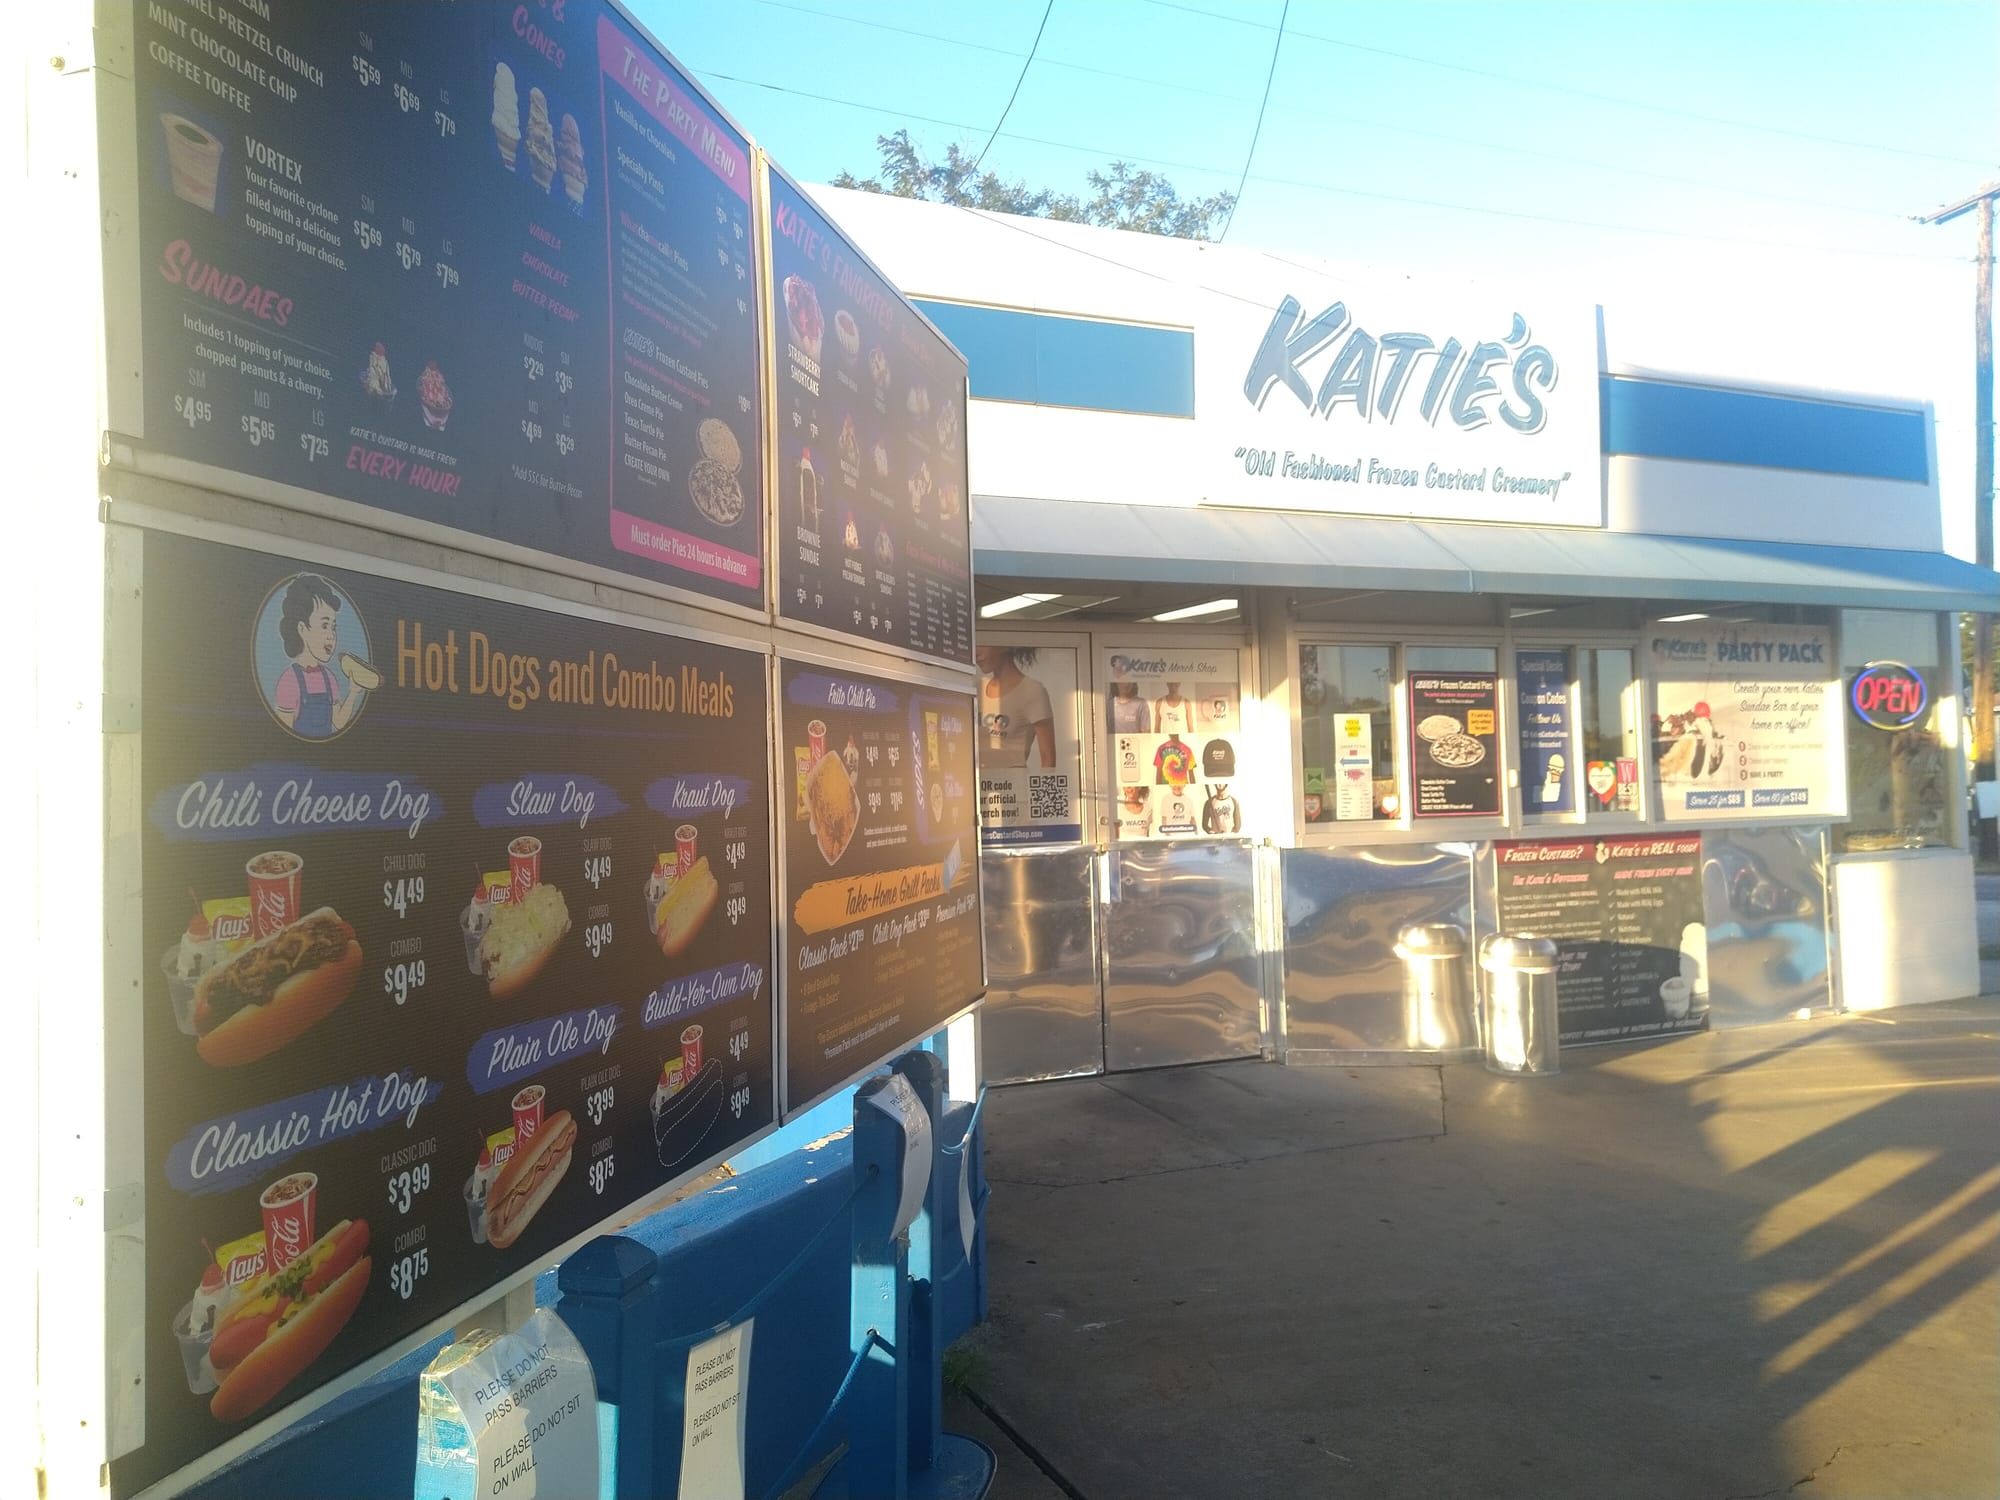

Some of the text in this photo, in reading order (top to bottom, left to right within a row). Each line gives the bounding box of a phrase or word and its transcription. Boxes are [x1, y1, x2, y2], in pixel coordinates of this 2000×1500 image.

[149, 3, 188, 39] MINT
[190, 27, 267, 88] CHOCOLATE
[268, 75, 298, 104] CHIP
[218, 6, 274, 57] PRETZEL
[275, 45, 324, 88] CRUNCH
[512, 4, 566, 70] CONES
[149, 41, 251, 113] COFFEE TOFFEE
[614, 99, 639, 132] Vanilla
[646, 127, 676, 164] Chocolate
[623, 46, 736, 179] THE PARTY MENU
[245, 135, 303, 185] VORTEX
[245, 166, 339, 225] Your favorite cyclone
[246, 189, 270, 212] filled
[272, 202, 294, 226] with
[302, 218, 342, 248] delicious
[246, 213, 348, 272] topping of your choice.
[776, 199, 831, 272] KATIE'S
[159, 239, 294, 327] SUNDAES
[183, 313, 224, 341] Includes
[233, 333, 270, 360] topping
[272, 348, 282, 362] of
[282, 353, 303, 373] your
[304, 359, 334, 382] choice,
[676, 359, 698, 383] Custard
[1243, 294, 1559, 435] KATIE'S
[195, 343, 237, 369] chopped
[240, 361, 278, 384] peanuts
[278, 371, 286, 385] &
[295, 377, 325, 400] cherry.
[346, 445, 461, 497] EVERY HOUR!
[1281, 451, 1362, 483] Fashioned
[1368, 458, 1420, 486] Frozen
[1425, 463, 1488, 493] Custard
[631, 524, 748, 577] Must order Pies 24 hours in advance
[398, 619, 735, 719] Hot Dogs and Combo Meals
[1129, 658, 1217, 676] KATIE'S Merch Shop
[1717, 641, 1824, 663] PARTY PACK
[847, 684, 865, 708] Chili
[864, 688, 876, 710] Pie
[1546, 692, 1566, 704] Codes
[1733, 681, 1799, 699] Create your own
[1739, 700, 1819, 717] Sundae Bar at your
[1856, 677, 1920, 713] OPEN
[1751, 719, 1771, 730] home
[176, 778, 431, 839] Chili Cheese Dog
[506, 780, 595, 831] Slaw Dog
[672, 779, 736, 820] Kraut Dog
[981, 780, 1012, 791] QR code
[988, 794, 1016, 805] official
[1002, 808, 1019, 818] now!
[1504, 849, 1538, 862] FROZEN
[1539, 845, 1584, 861] CUSTARD?
[1611, 843, 1640, 857] KATIE'S
[1650, 842, 1675, 855] REAL
[845, 882, 898, 917] Take-Home
[900, 873, 921, 903] Grill
[390, 937, 422, 957] COMBO
[799, 935, 849, 971] Classic Pack
[873, 913, 918, 948] Chili Dog Pack
[644, 971, 739, 1024] Build-Yer-Own
[740, 962, 763, 1000] Dog
[487, 1009, 616, 1078] Plain Ole Dog
[190, 1072, 428, 1179] Classic Hot Dog
[380, 1137, 437, 1174] CLASSIC DOG
[394, 1225, 426, 1254] COMBO
[474, 1343, 550, 1405] PLEASE DO NOT
[694, 1364, 734, 1395] PASS BARRIERS
[696, 1347, 737, 1377] PLEASE DO NOT
[484, 1364, 558, 1429] PASS BARRIERS
[693, 1392, 741, 1430] PLEASE DO NOT SIT
[493, 1394, 581, 1474] PLEASE DO NOT SIT
[692, 1425, 713, 1447] ON WALL
[492, 1455, 538, 1496] ON WALL
